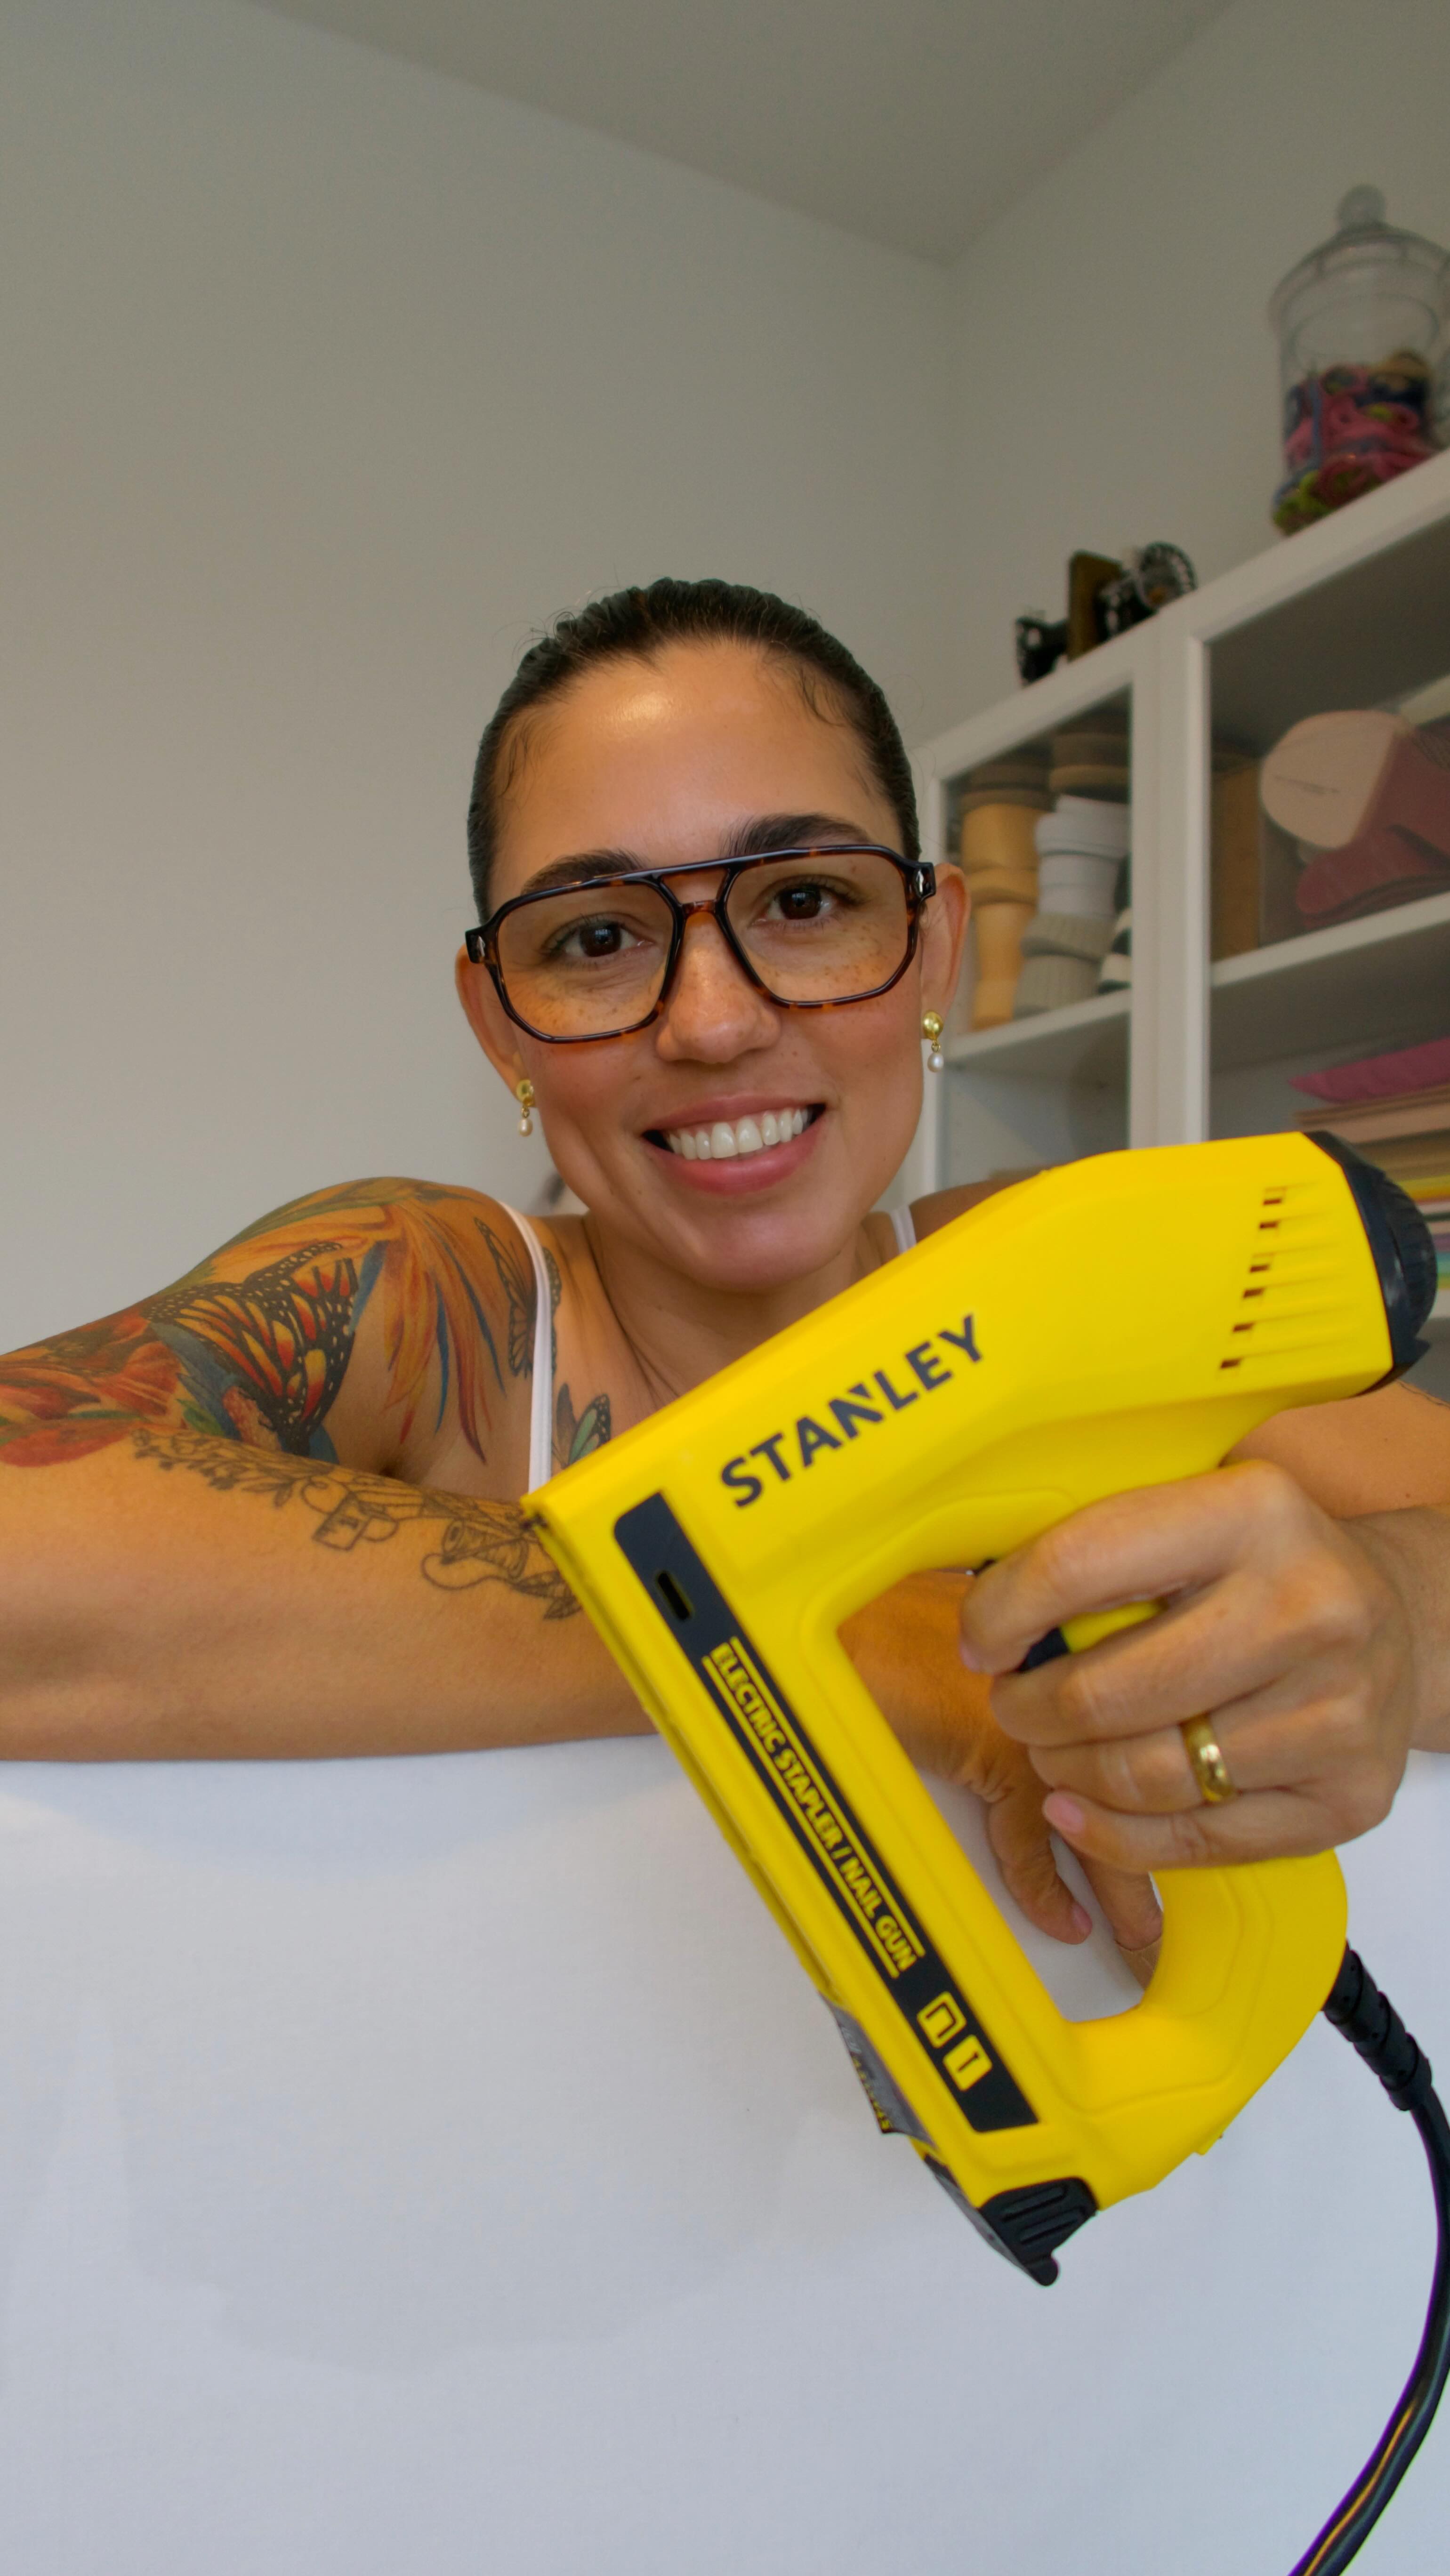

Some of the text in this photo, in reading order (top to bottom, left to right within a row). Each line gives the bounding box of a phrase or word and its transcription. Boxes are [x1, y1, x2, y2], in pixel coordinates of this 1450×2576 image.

[719, 1314, 983, 1508] STANLEY
[710, 1642, 917, 1972] ELECTRIC STAPLER / NAIL GUN
